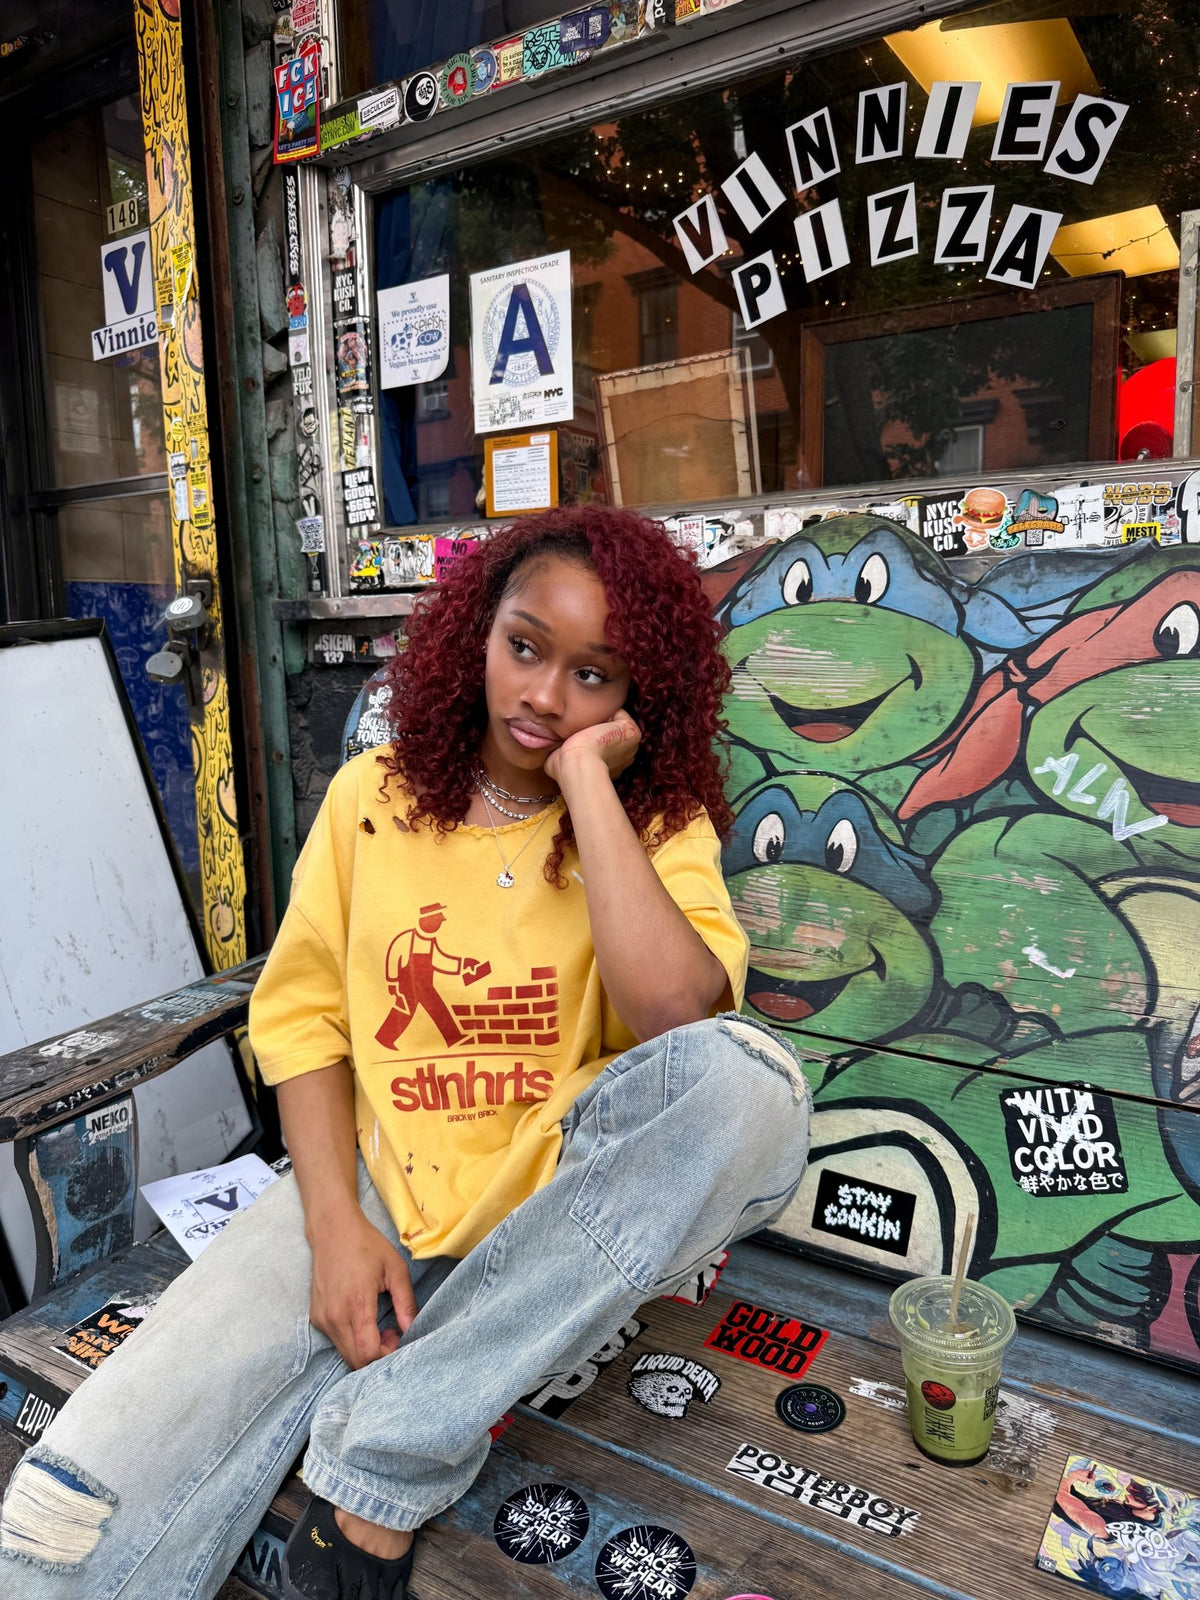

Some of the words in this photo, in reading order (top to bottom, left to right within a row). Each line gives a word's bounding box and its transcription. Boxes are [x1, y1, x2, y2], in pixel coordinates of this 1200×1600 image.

[278, 53, 315, 89] FCK
[282, 80, 315, 112] ICE
[678, 85, 1117, 261] VINNIES
[108, 202, 137, 231] 148
[480, 273, 505, 284] SANITARY
[506, 264, 539, 277] INSPECTION
[540, 259, 560, 269] GRADE
[738, 190, 1043, 323] PIZZA
[104, 241, 146, 315] V
[334, 285, 355, 302] KUSH
[336, 272, 353, 287] NYC
[391, 310, 400, 318] We
[401, 305, 425, 317] proudly
[426, 303, 437, 311] use
[489, 283, 555, 385] A
[389, 359, 408, 369] Vegan
[408, 353, 441, 365] Mozzarella
[544, 387, 563, 399] NYC
[340, 409, 355, 469] TENANT
[926, 501, 961, 519] NYC
[451, 542, 467, 555] NO
[933, 536, 958, 552] CO.
[357, 729, 391, 744] TONES
[91, 1106, 129, 1133] NEKO
[447, 1113, 467, 1123] BRICK
[467, 1112, 476, 1121] BY
[478, 1109, 498, 1119] BRICK
[1014, 1141, 1120, 1173] COLOR
[194, 1186, 239, 1212] V
[837, 1183, 893, 1214] STAY
[823, 1202, 901, 1241] COOKIN
[725, 1301, 823, 1352] GOLD
[710, 1324, 809, 1375] WOOD
[632, 1354, 685, 1373] LIQUID
[681, 1360, 719, 1403] DEATH
[736, 1447, 919, 1524] POSTERBOY
[507, 1508, 530, 1528] WE
[531, 1519, 571, 1549] HEAR
[611, 1550, 637, 1572] WE
[636, 1565, 677, 1599] HEAR
